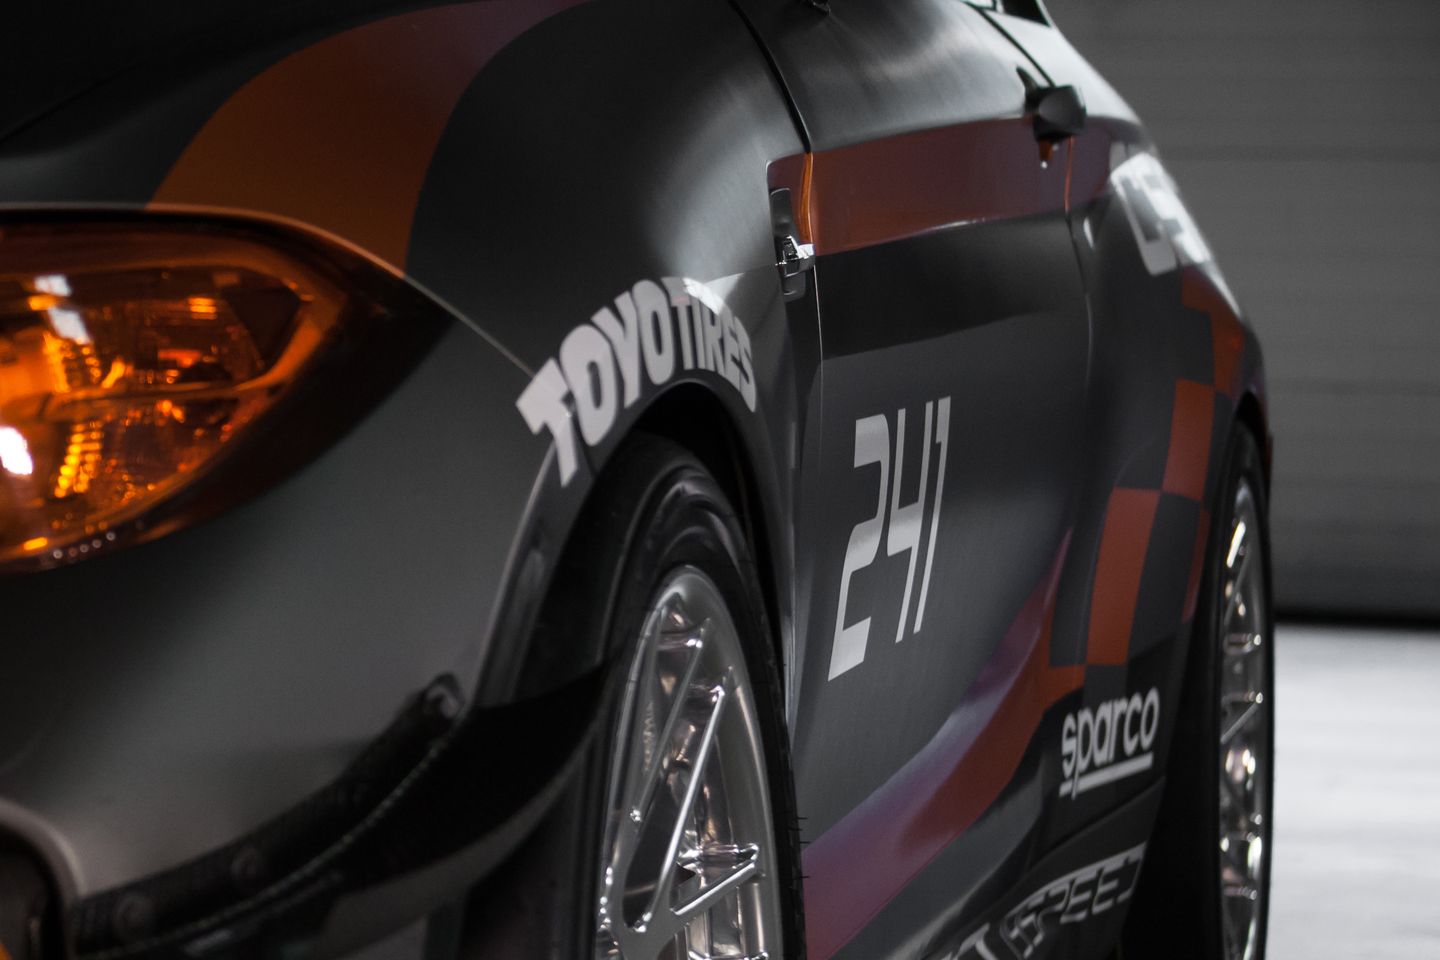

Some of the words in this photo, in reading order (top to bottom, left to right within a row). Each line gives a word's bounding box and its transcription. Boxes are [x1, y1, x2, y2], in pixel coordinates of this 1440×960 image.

[516, 279, 675, 487] TOYO
[661, 277, 757, 412] TIRES
[828, 396, 950, 681] 241
[1061, 685, 1159, 799] sparco
